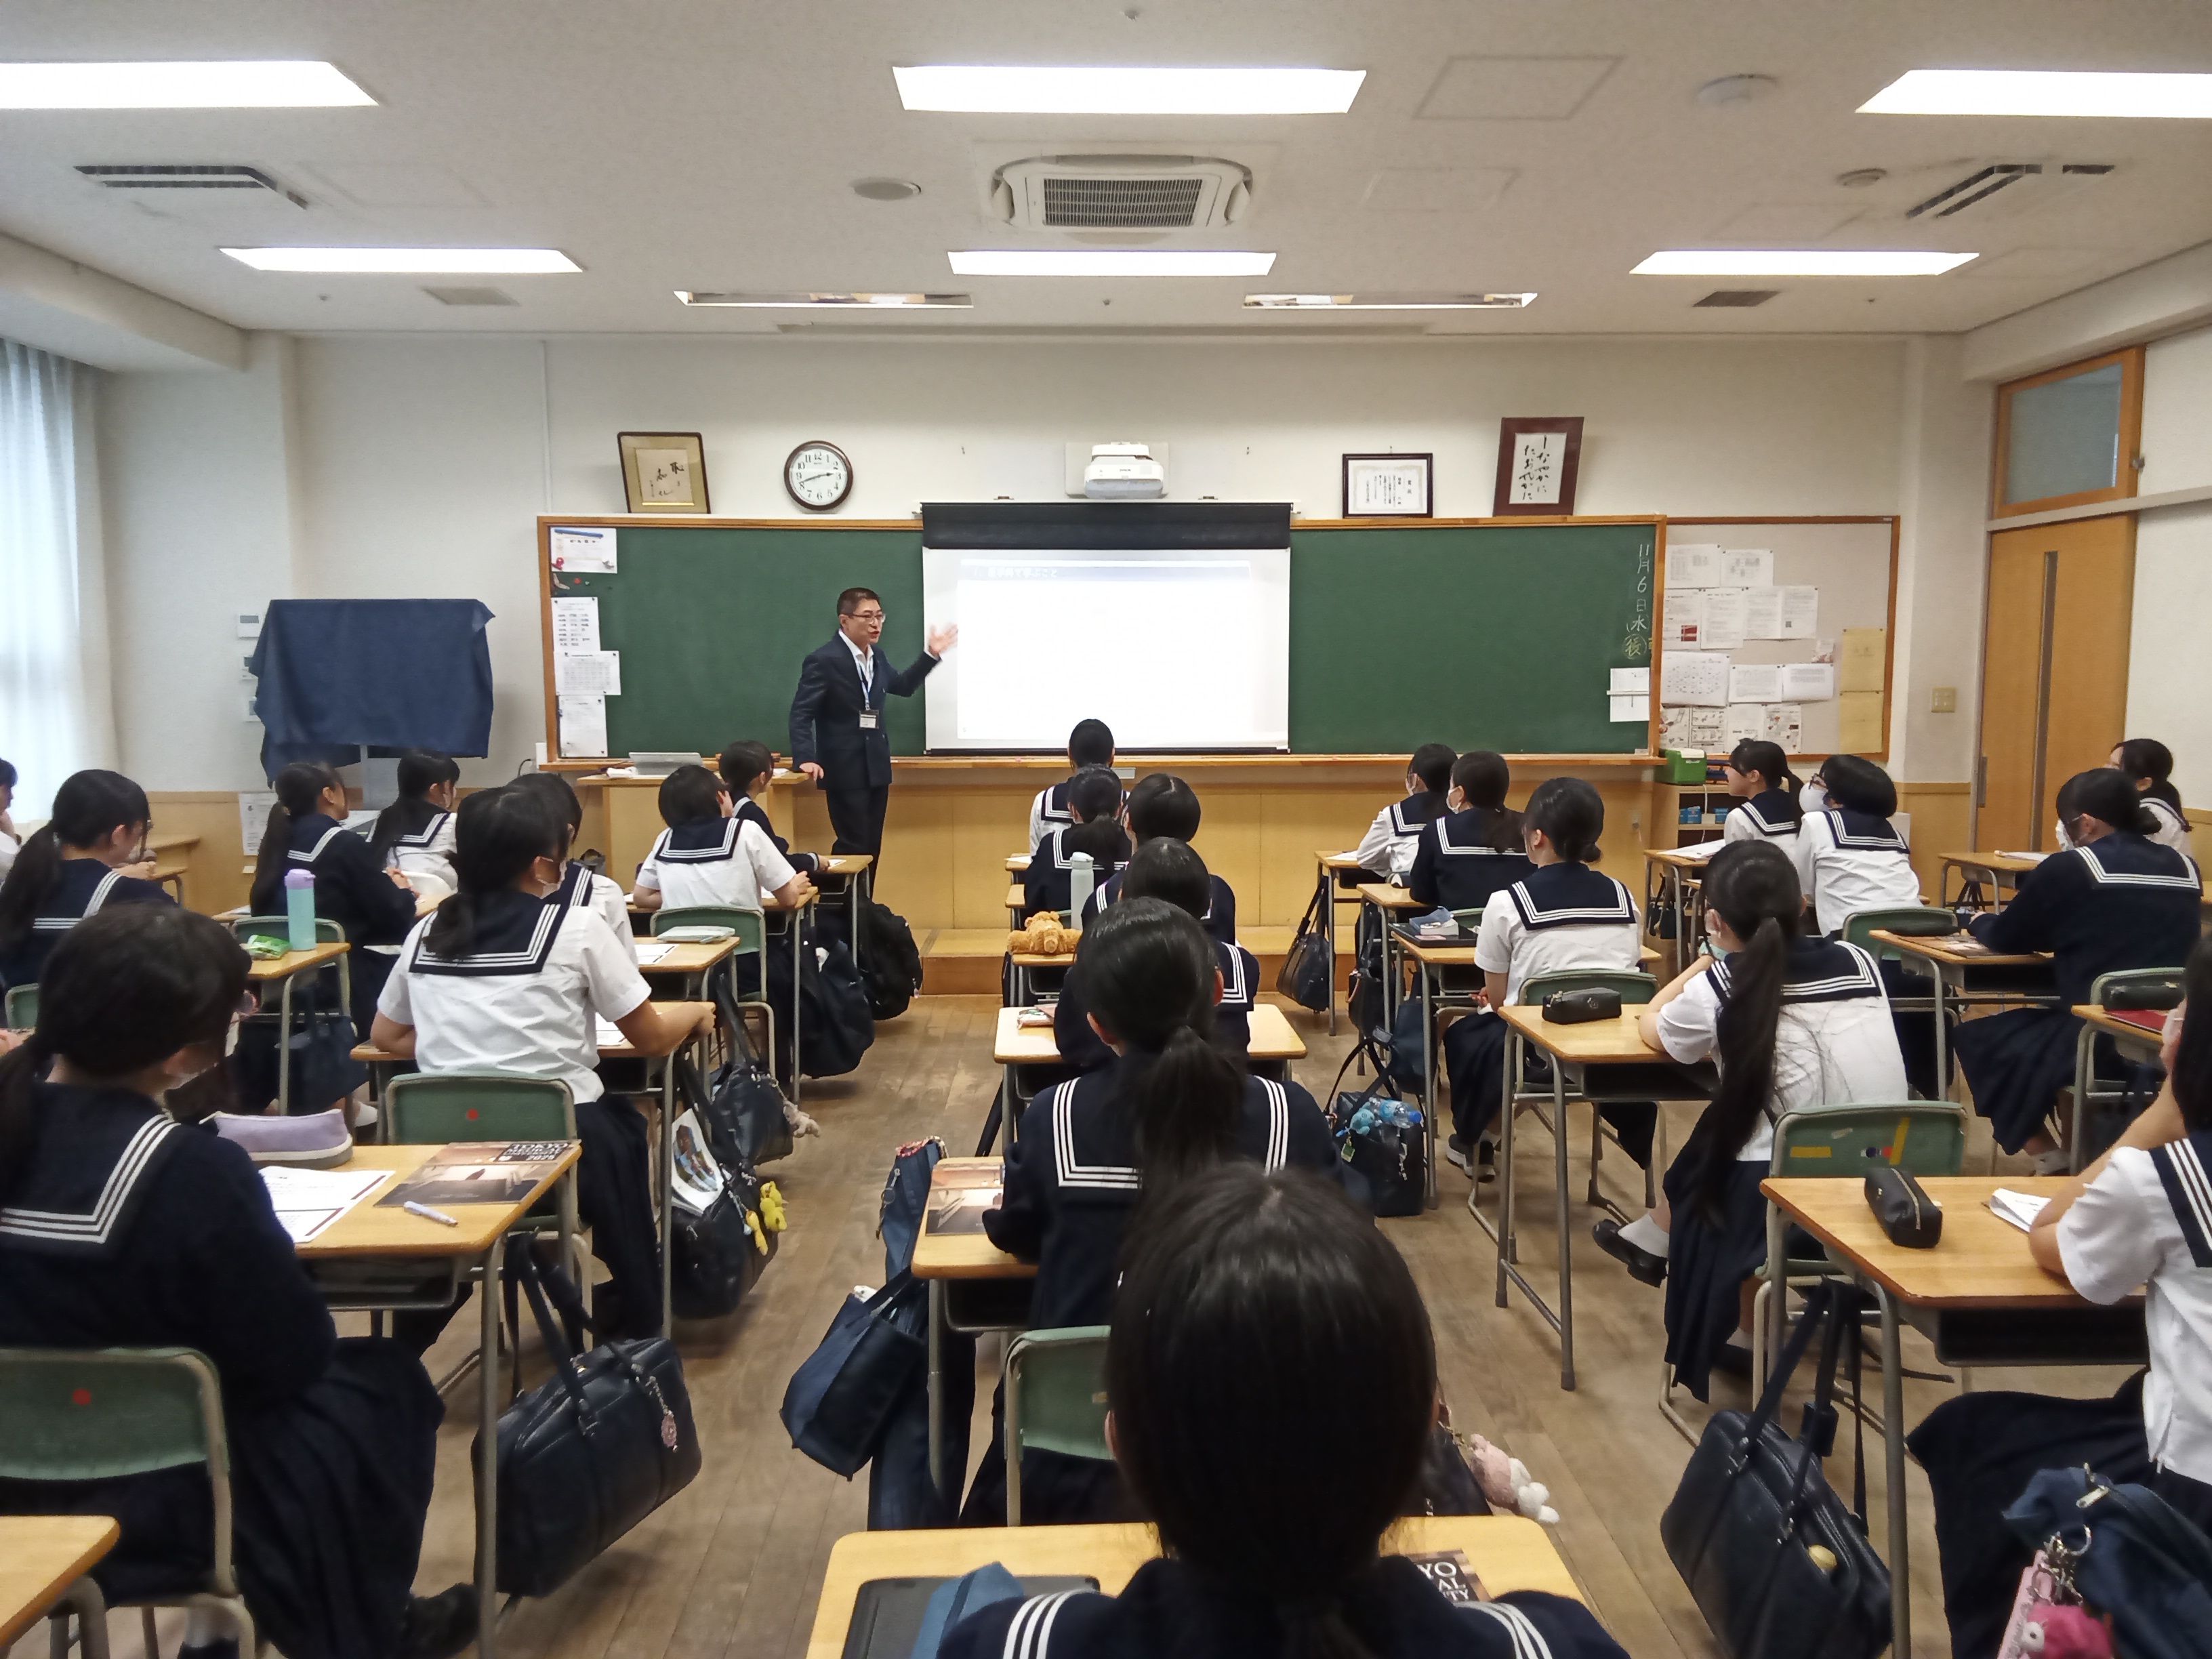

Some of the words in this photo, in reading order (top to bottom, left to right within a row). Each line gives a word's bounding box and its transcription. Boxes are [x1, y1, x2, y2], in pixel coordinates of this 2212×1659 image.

[805, 455, 811, 463] 11
[814, 451, 822, 460] 12
[826, 454, 830, 462] 1
[798, 462, 805, 470] 10
[833, 462, 838, 470] 2
[1534, 434, 1550, 493] しなやかに
[1519, 445, 1535, 500] たおやかに
[799, 481, 805, 490] 8
[807, 489, 812, 497] 7
[817, 492, 823, 500] 6
[827, 489, 833, 497] 5
